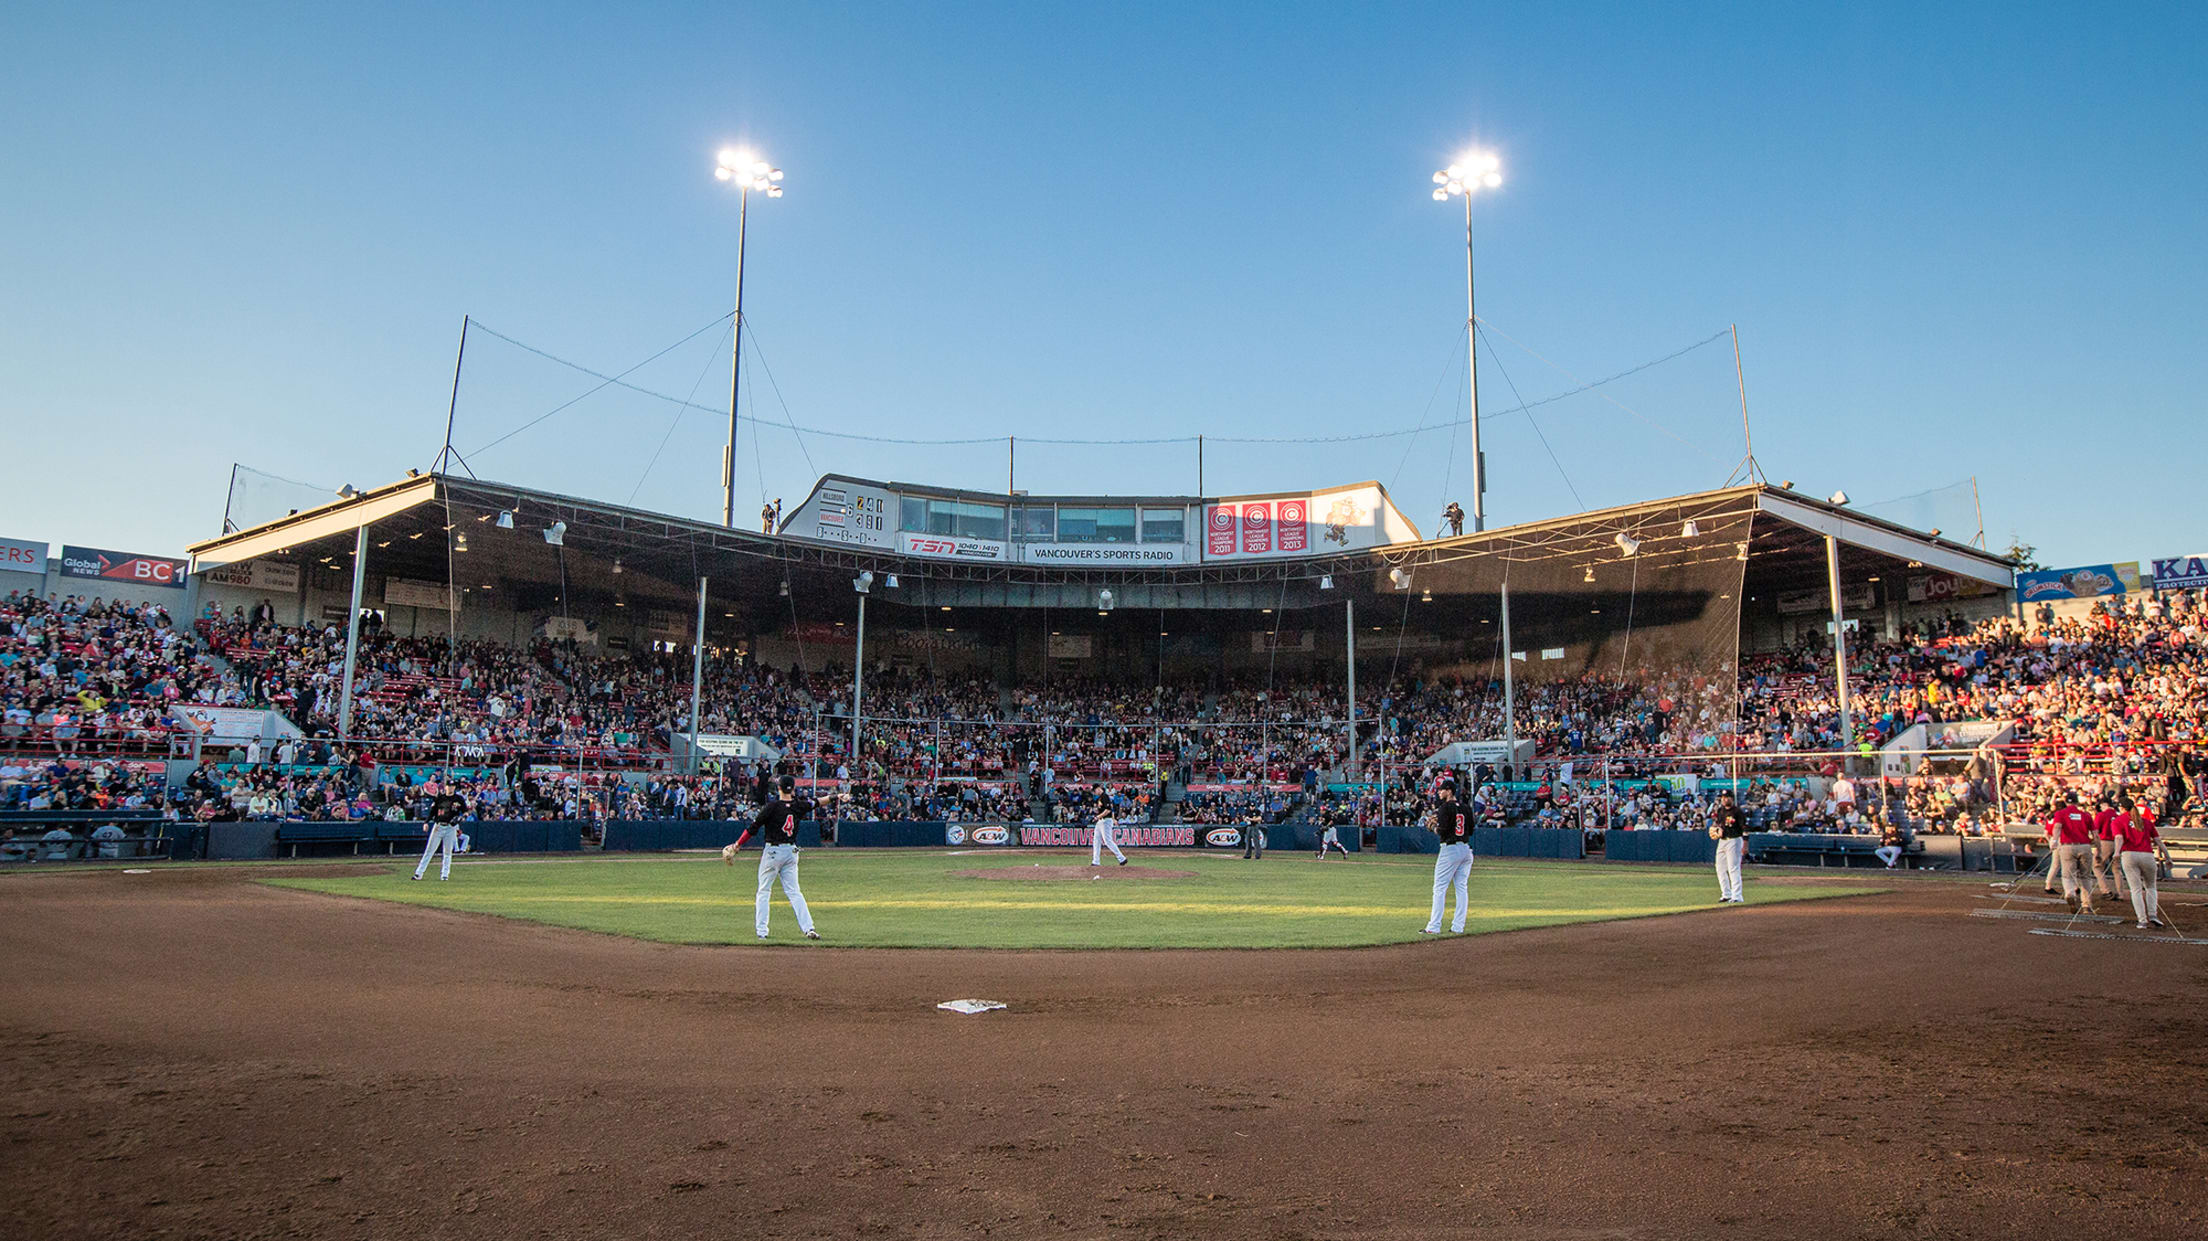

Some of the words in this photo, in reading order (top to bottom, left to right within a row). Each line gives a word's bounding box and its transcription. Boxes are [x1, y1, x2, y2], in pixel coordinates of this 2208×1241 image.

[848, 504, 853, 517] 6
[857, 497, 864, 510] 2
[867, 498, 873, 511] 4
[820, 513, 844, 523] VANCOUVER
[910, 539, 956, 555] TSN
[958, 542, 979, 550] 1040
[982, 544, 1000, 552] 1410
[1214, 545, 1231, 553] 2011
[1248, 543, 1266, 551] 2012
[1283, 541, 1302, 549] 2013
[1035, 549, 1101, 560] VANCOUVER'S
[1103, 550, 1141, 560] SPORTS
[1143, 551, 1174, 561] RADIO
[64, 557, 101, 570] Global
[134, 560, 170, 581] BC
[175, 566, 185, 582] 1
[73, 567, 100, 576] NEWS
[2024, 582, 2064, 599] DRUMSTICK
[782, 815, 795, 837] 4
[1455, 813, 1465, 836] 3
[1020, 827, 1097, 845] VANCOUVE
[1112, 827, 1195, 845] CANADIANS
